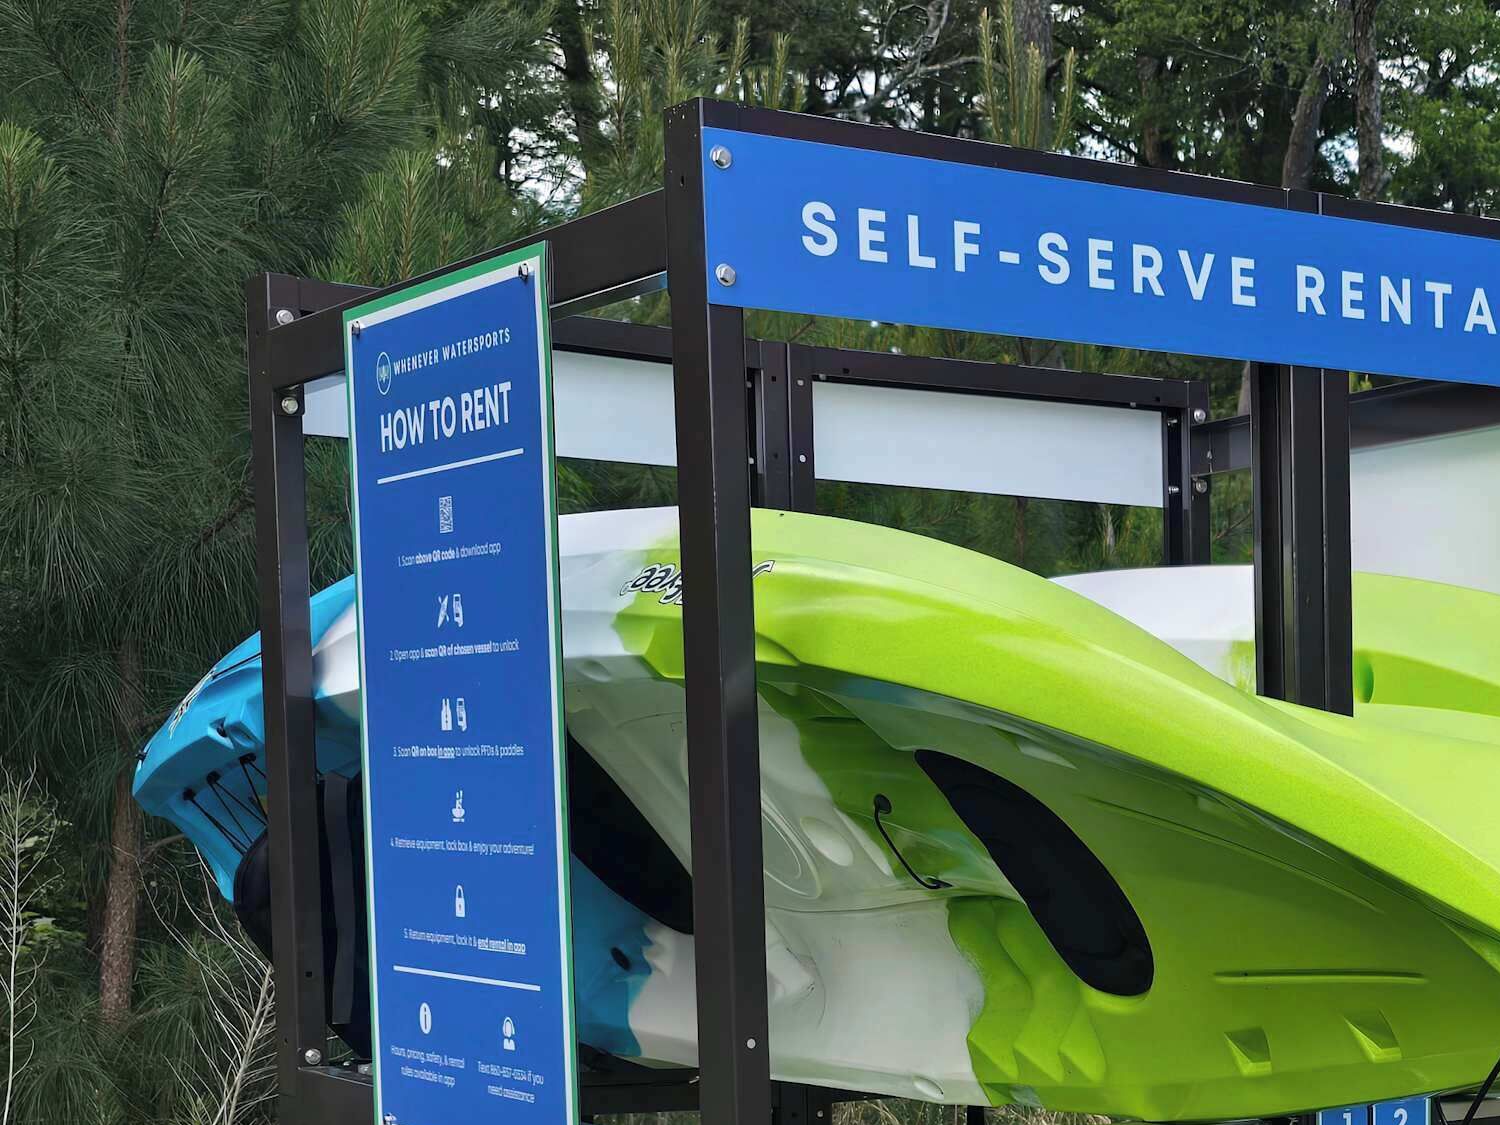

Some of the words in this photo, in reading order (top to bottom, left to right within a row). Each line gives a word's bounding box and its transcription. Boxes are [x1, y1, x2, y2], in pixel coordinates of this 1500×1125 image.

[800, 201, 1257, 308] SELF-SERVE
[393, 350, 439, 376] WHENEVER
[442, 328, 511, 359] WATERSPORTS
[380, 404, 425, 452] HOW
[430, 396, 457, 441] TO
[461, 381, 512, 434] RENT
[489, 542, 501, 557] app
